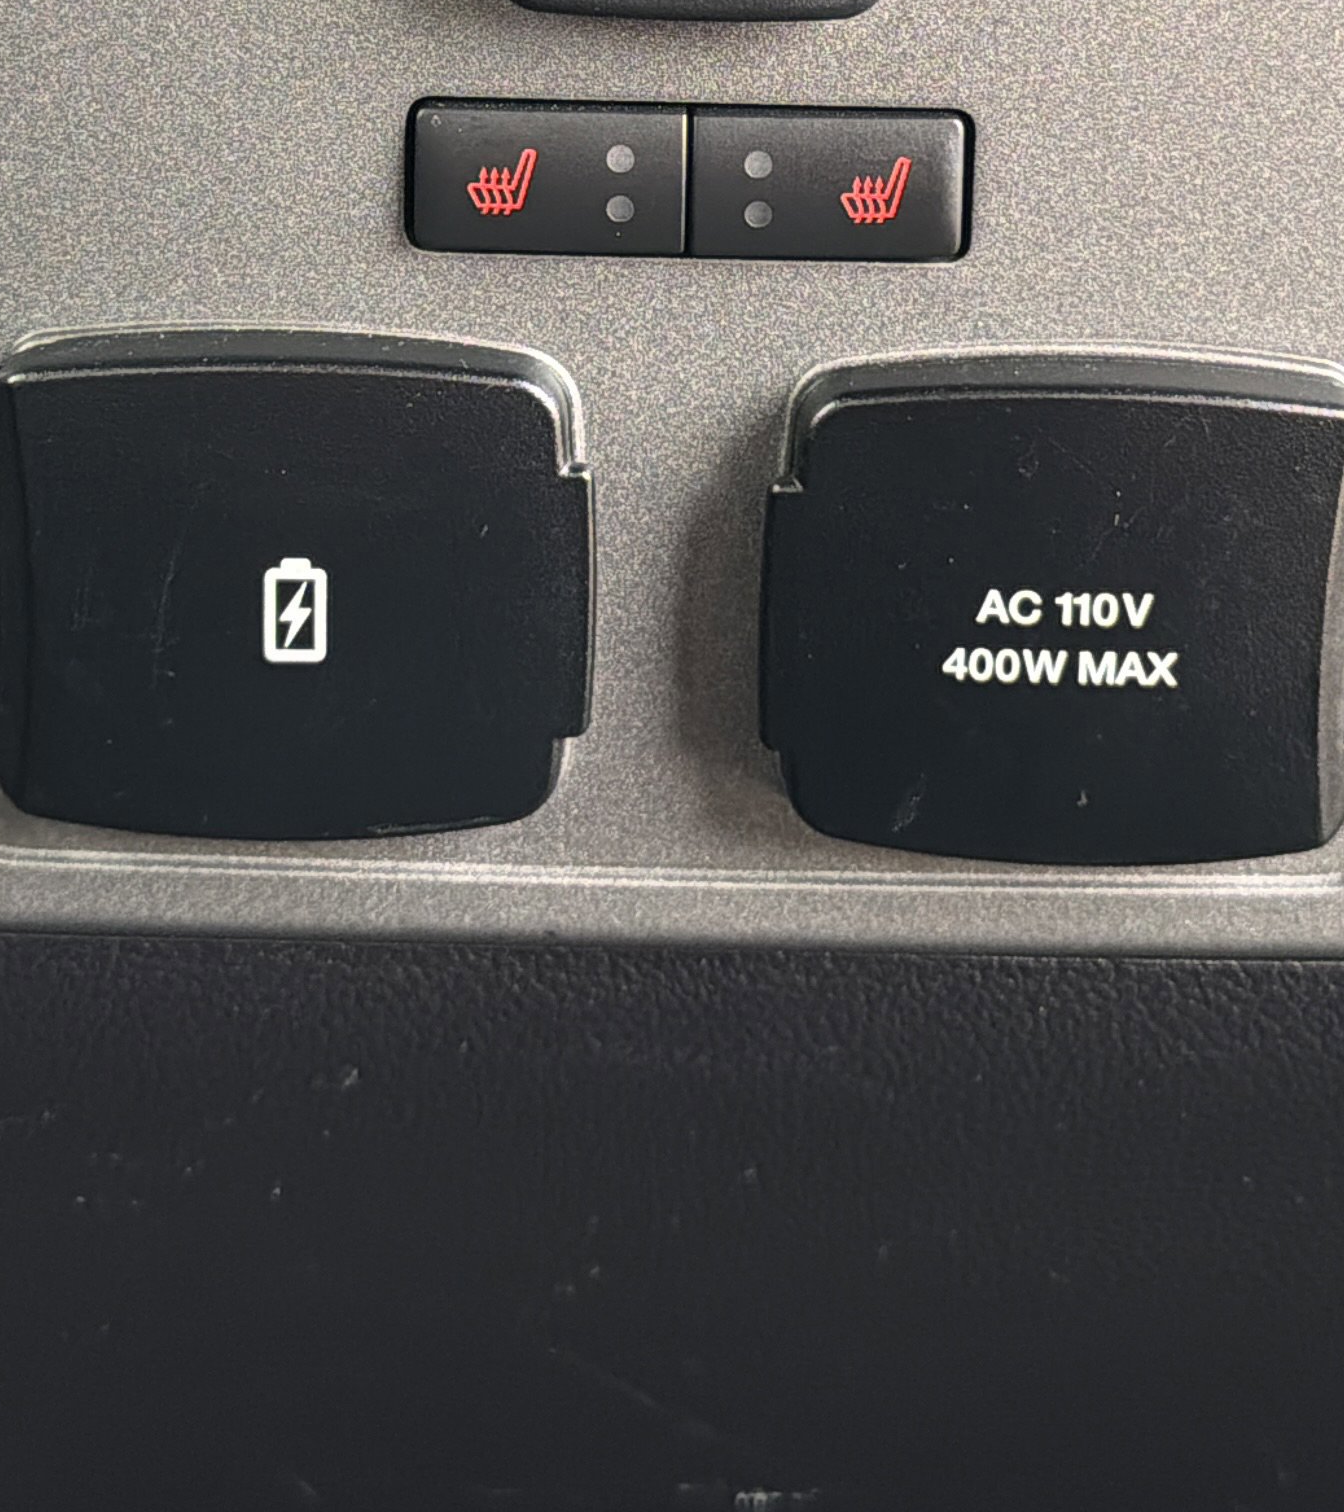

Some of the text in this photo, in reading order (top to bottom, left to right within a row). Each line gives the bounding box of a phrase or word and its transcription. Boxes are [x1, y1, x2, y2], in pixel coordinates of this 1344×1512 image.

[975, 588, 1155, 629] AC 110V
[941, 647, 1179, 688] 400W MAX
